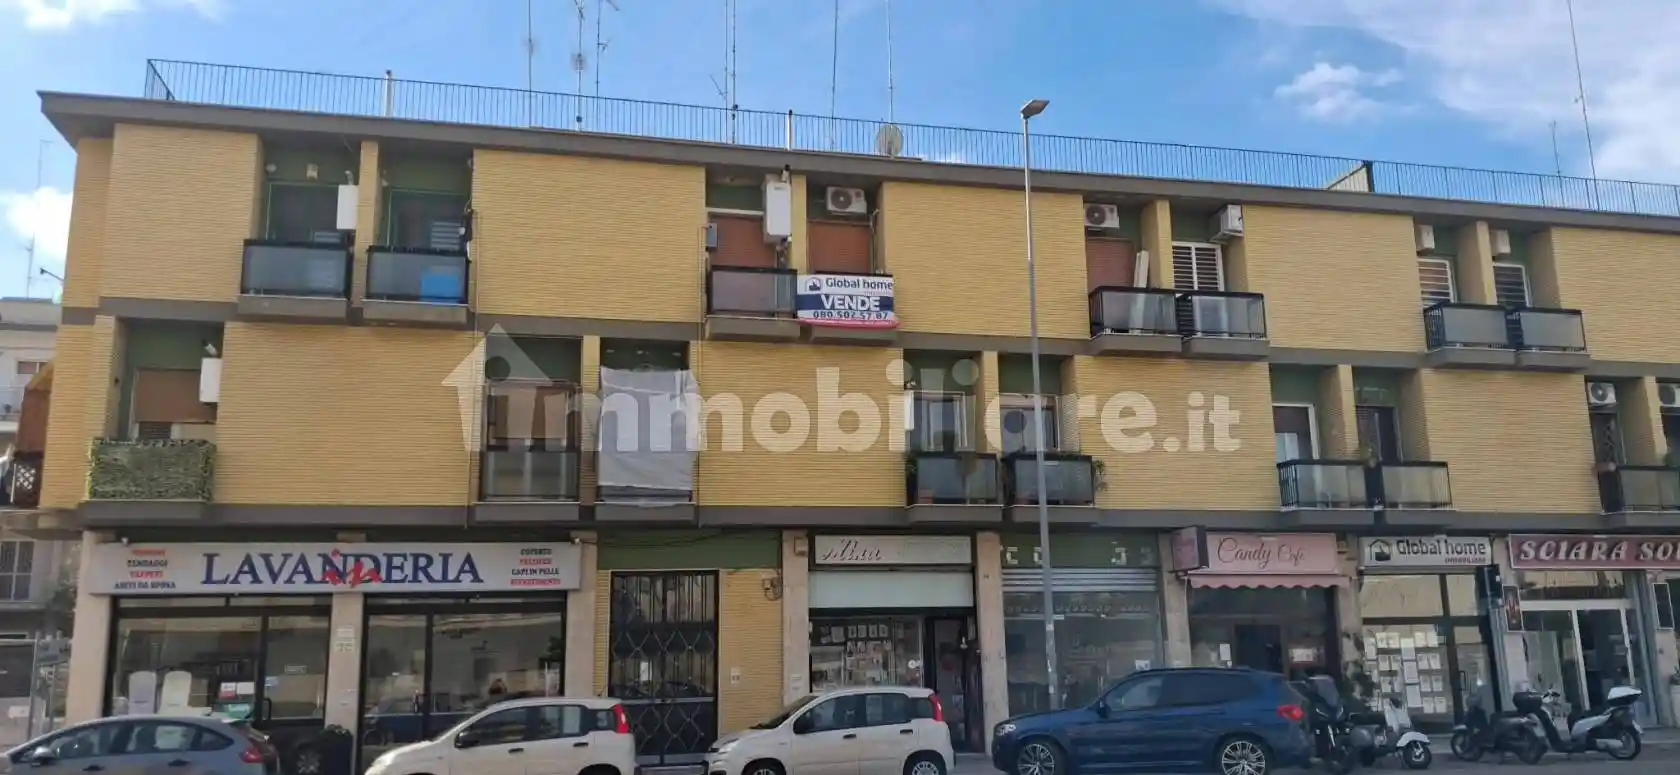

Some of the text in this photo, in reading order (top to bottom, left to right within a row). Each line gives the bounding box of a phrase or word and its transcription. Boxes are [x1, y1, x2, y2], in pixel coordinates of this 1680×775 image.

[825, 277, 893, 291] Global home
[820, 294, 881, 311] VENDE
[813, 311, 833, 319] 080
[860, 311, 871, 320] 57
[1217, 537, 1272, 569] Candy
[1396, 538, 1487, 555] Global home
[1519, 539, 1680, 561] SCIARA SO
[201, 552, 484, 585] LAVANDERIA
